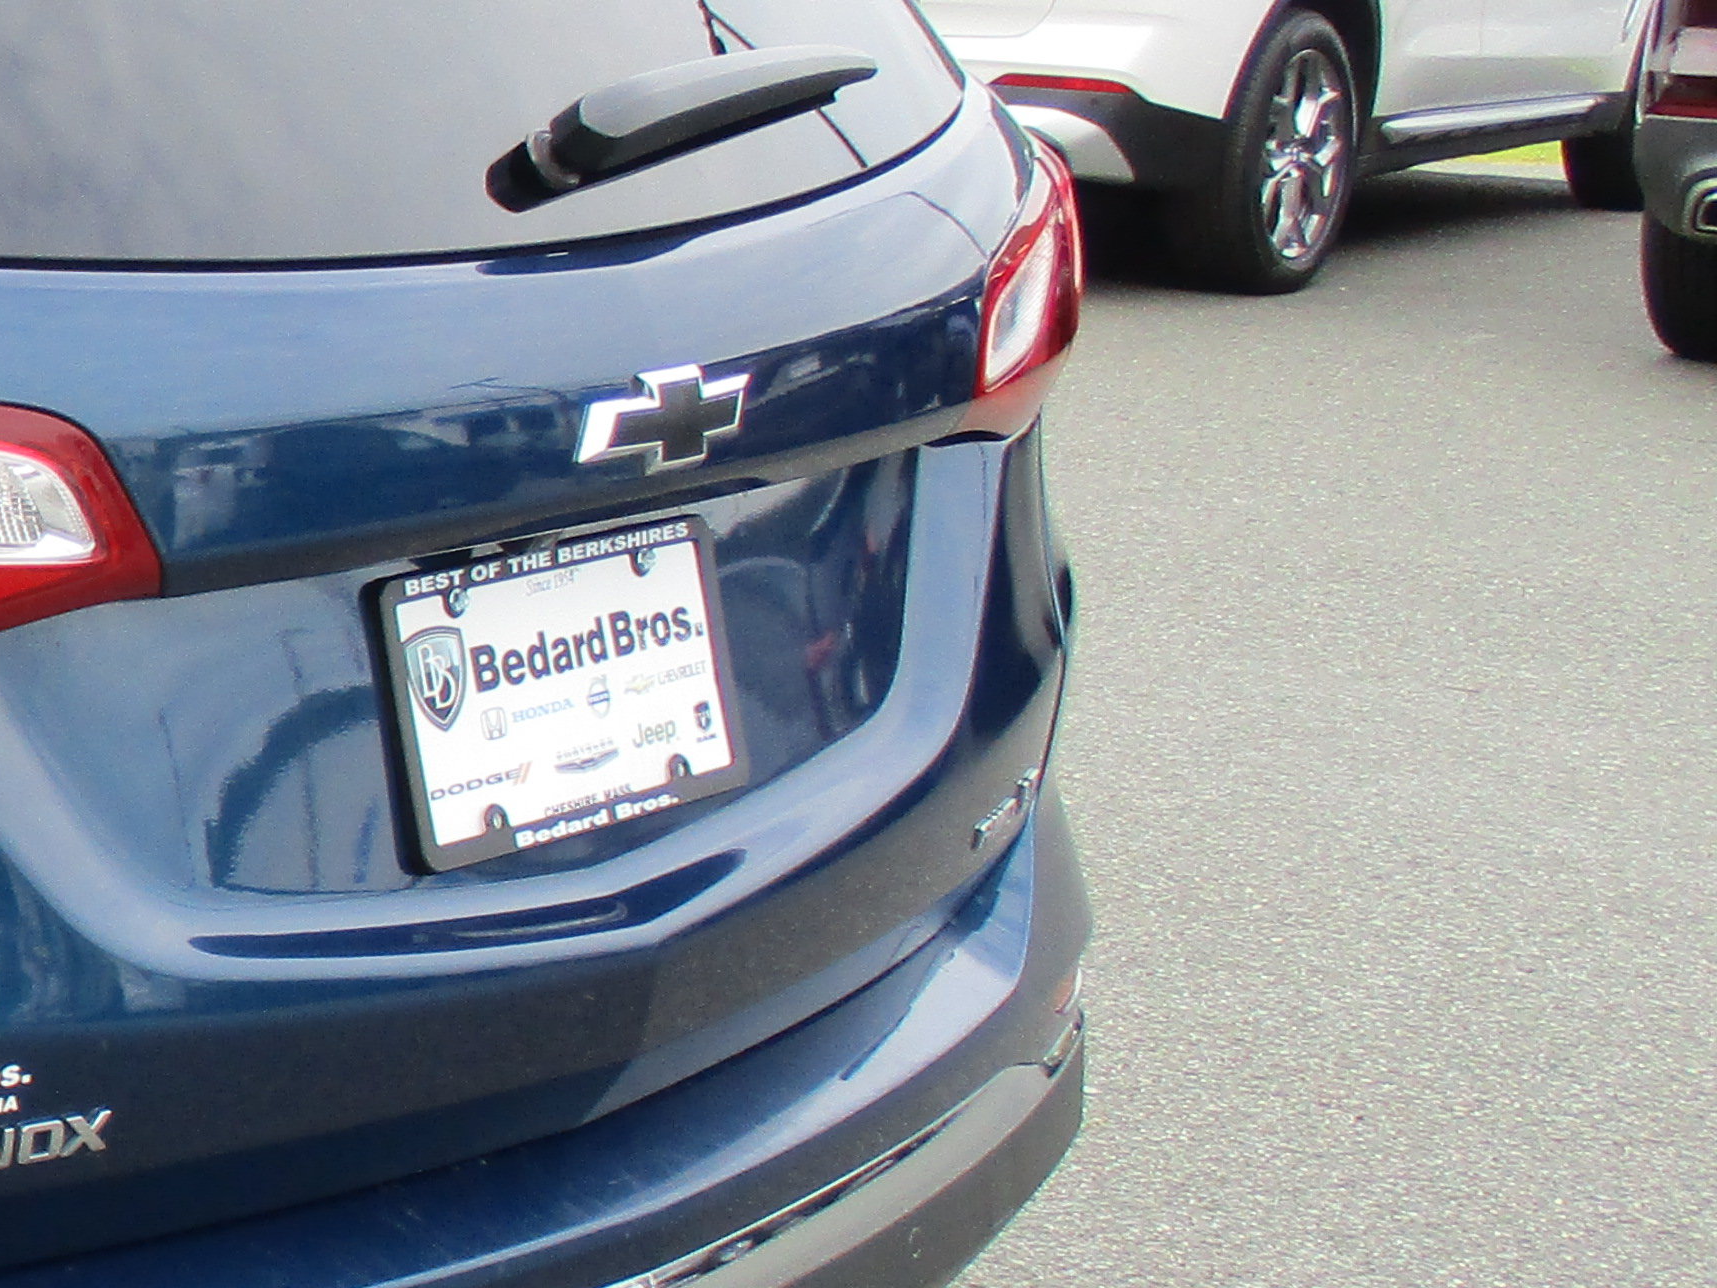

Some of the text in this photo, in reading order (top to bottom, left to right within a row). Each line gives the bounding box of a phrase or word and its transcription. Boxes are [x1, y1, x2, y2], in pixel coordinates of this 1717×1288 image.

[404, 521, 691, 597] BEST OF THE BERKSHIRES
[511, 697, 575, 724] HONDA
[632, 720, 677, 749] Jeep
[430, 768, 521, 800] DODGE
[515, 793, 679, 848] Bedard Bros.
